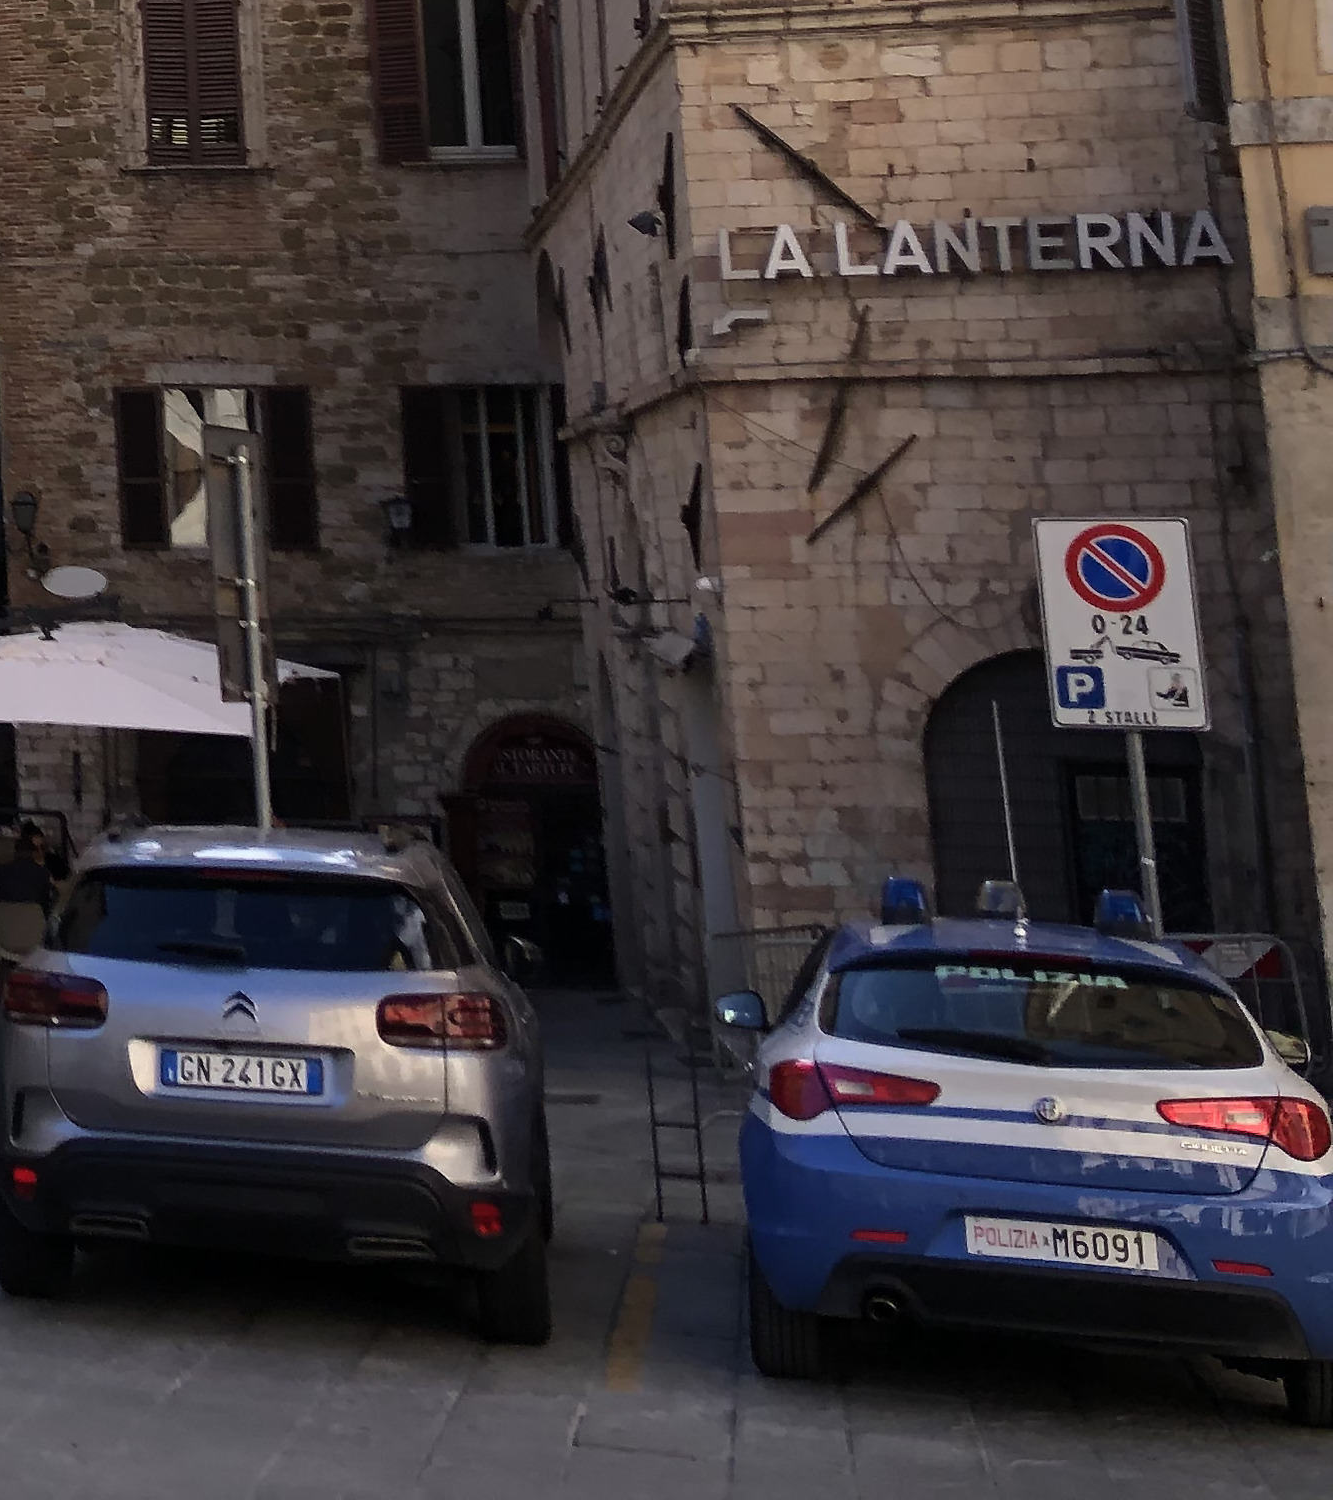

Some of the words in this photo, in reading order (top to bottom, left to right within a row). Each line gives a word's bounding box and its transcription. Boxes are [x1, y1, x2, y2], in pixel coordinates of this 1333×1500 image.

[719, 223, 813, 280] LA
[834, 209, 1233, 277] LANTERNA
[1066, 672, 1096, 703] P
[1087, 710, 1096, 723] 2
[1105, 710, 1158, 725] STALLI
[934, 965, 1129, 990] POLIZIA
[181, 1055, 211, 1082] GN
[221, 1057, 303, 1089] 241GX
[972, 1224, 1039, 1249] POLIZIA
[1052, 1227, 1145, 1265] M6091
